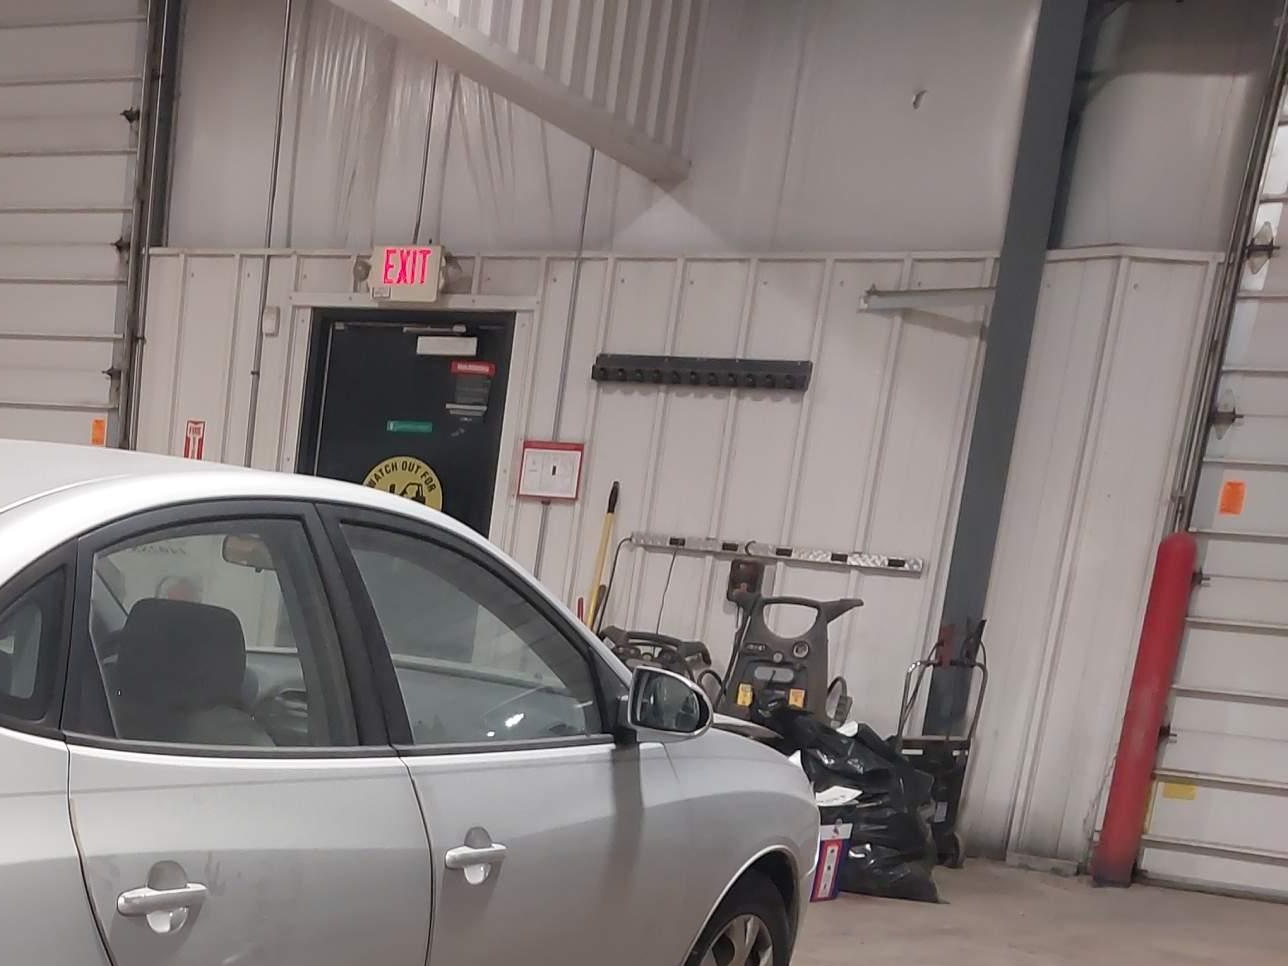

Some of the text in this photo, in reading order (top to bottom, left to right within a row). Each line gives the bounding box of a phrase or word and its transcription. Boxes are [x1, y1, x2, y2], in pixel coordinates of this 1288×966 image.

[383, 249, 432, 285] EXIT
[367, 460, 437, 493] WATCH OUT FOR
